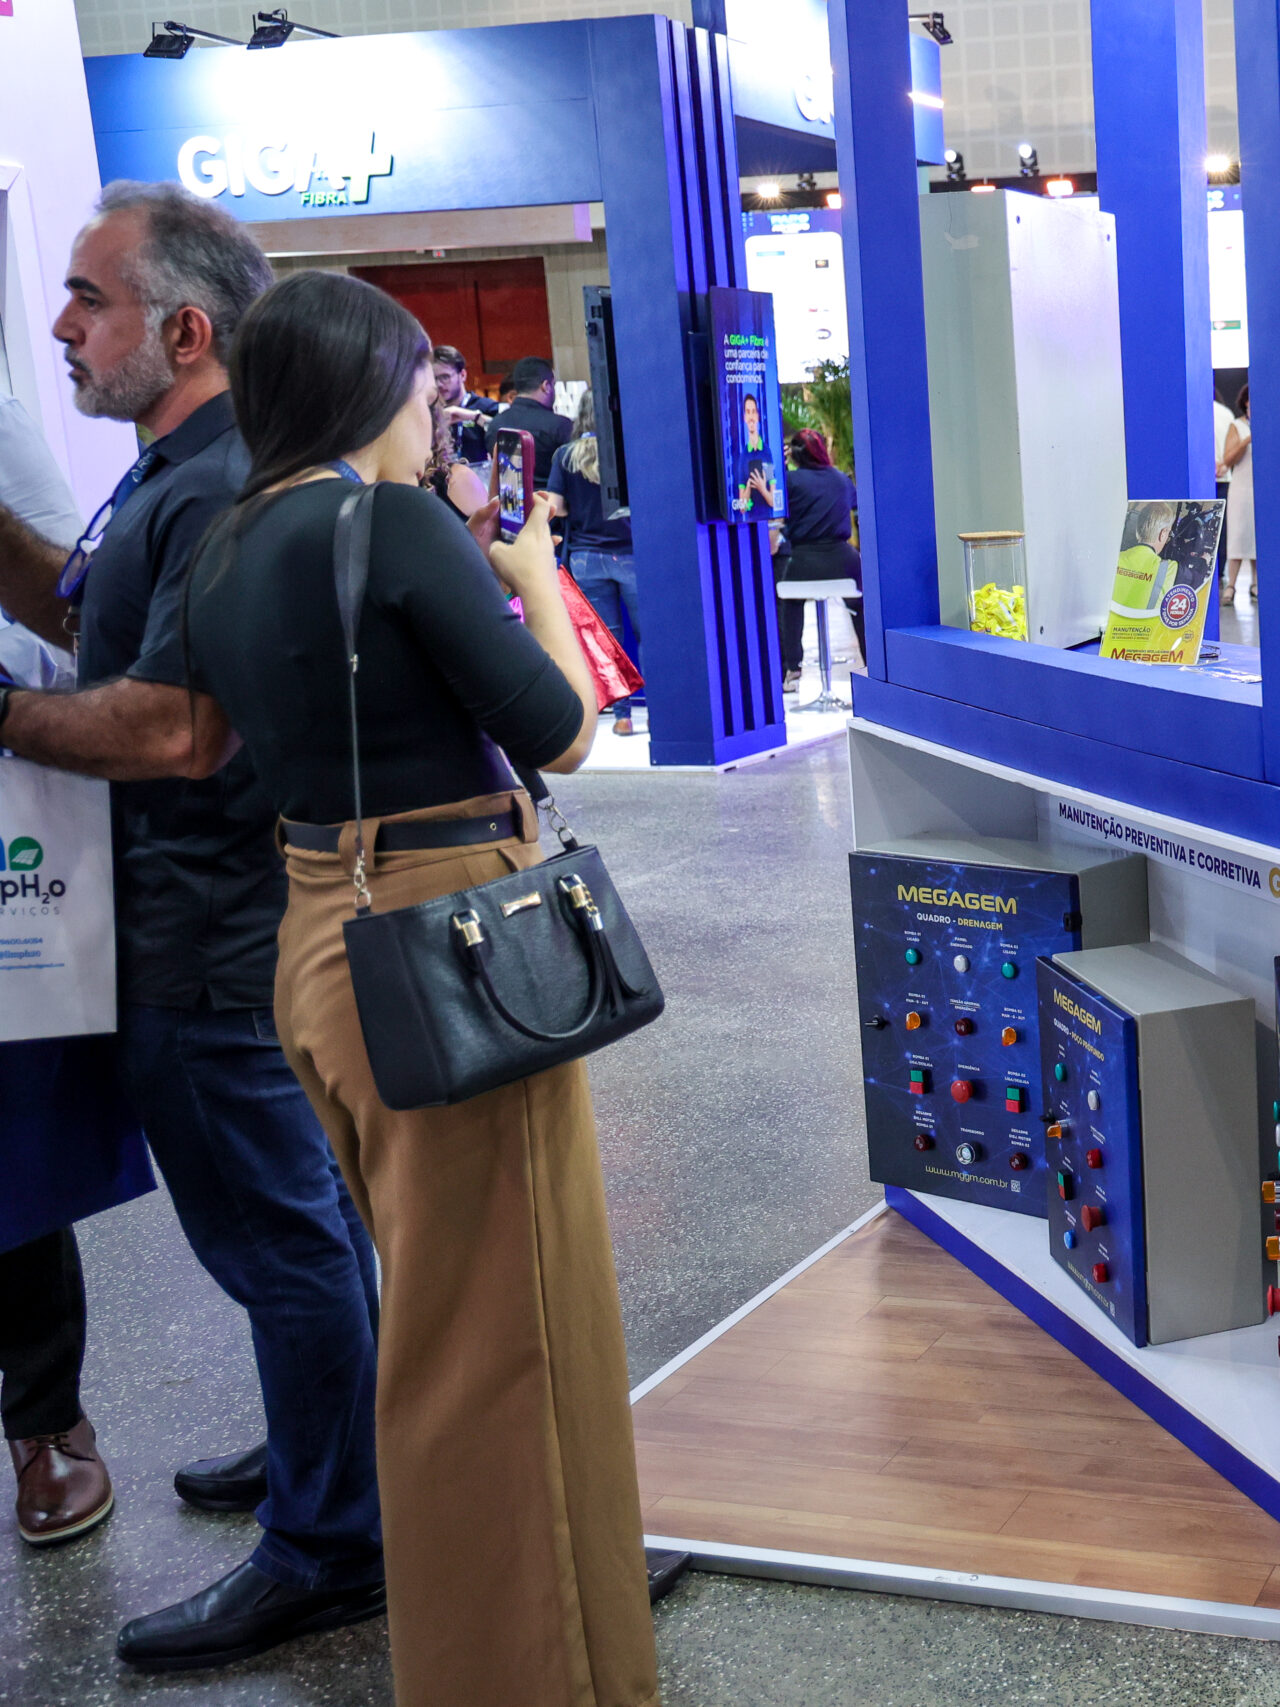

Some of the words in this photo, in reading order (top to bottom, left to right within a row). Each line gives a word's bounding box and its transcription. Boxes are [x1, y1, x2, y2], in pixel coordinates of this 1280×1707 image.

[301, 191, 348, 207] FIBRA
[724, 349, 738, 358] uma
[739, 348, 760, 359] parceira
[725, 360, 753, 371] confiança
[753, 361, 767, 371] para
[1165, 587, 1195, 602] ATENDIMENTO
[1171, 598, 1187, 610] 24
[1059, 802, 1123, 839] MANUTENÇÃO
[1125, 826, 1187, 864] PREVENTIVA
[1189, 849, 1195, 866] E
[1197, 852, 1261, 889] CORRETIVA
[897, 884, 1017, 915] MEGAGEM
[916, 912, 951, 924] QUADRO
[957, 917, 1003, 931] DRENAGEM
[1053, 988, 1102, 1036] MEGAGEM
[1054, 1018, 1069, 1036] QUADRO
[925, 1165, 1009, 1189] www.mggm.com.br
